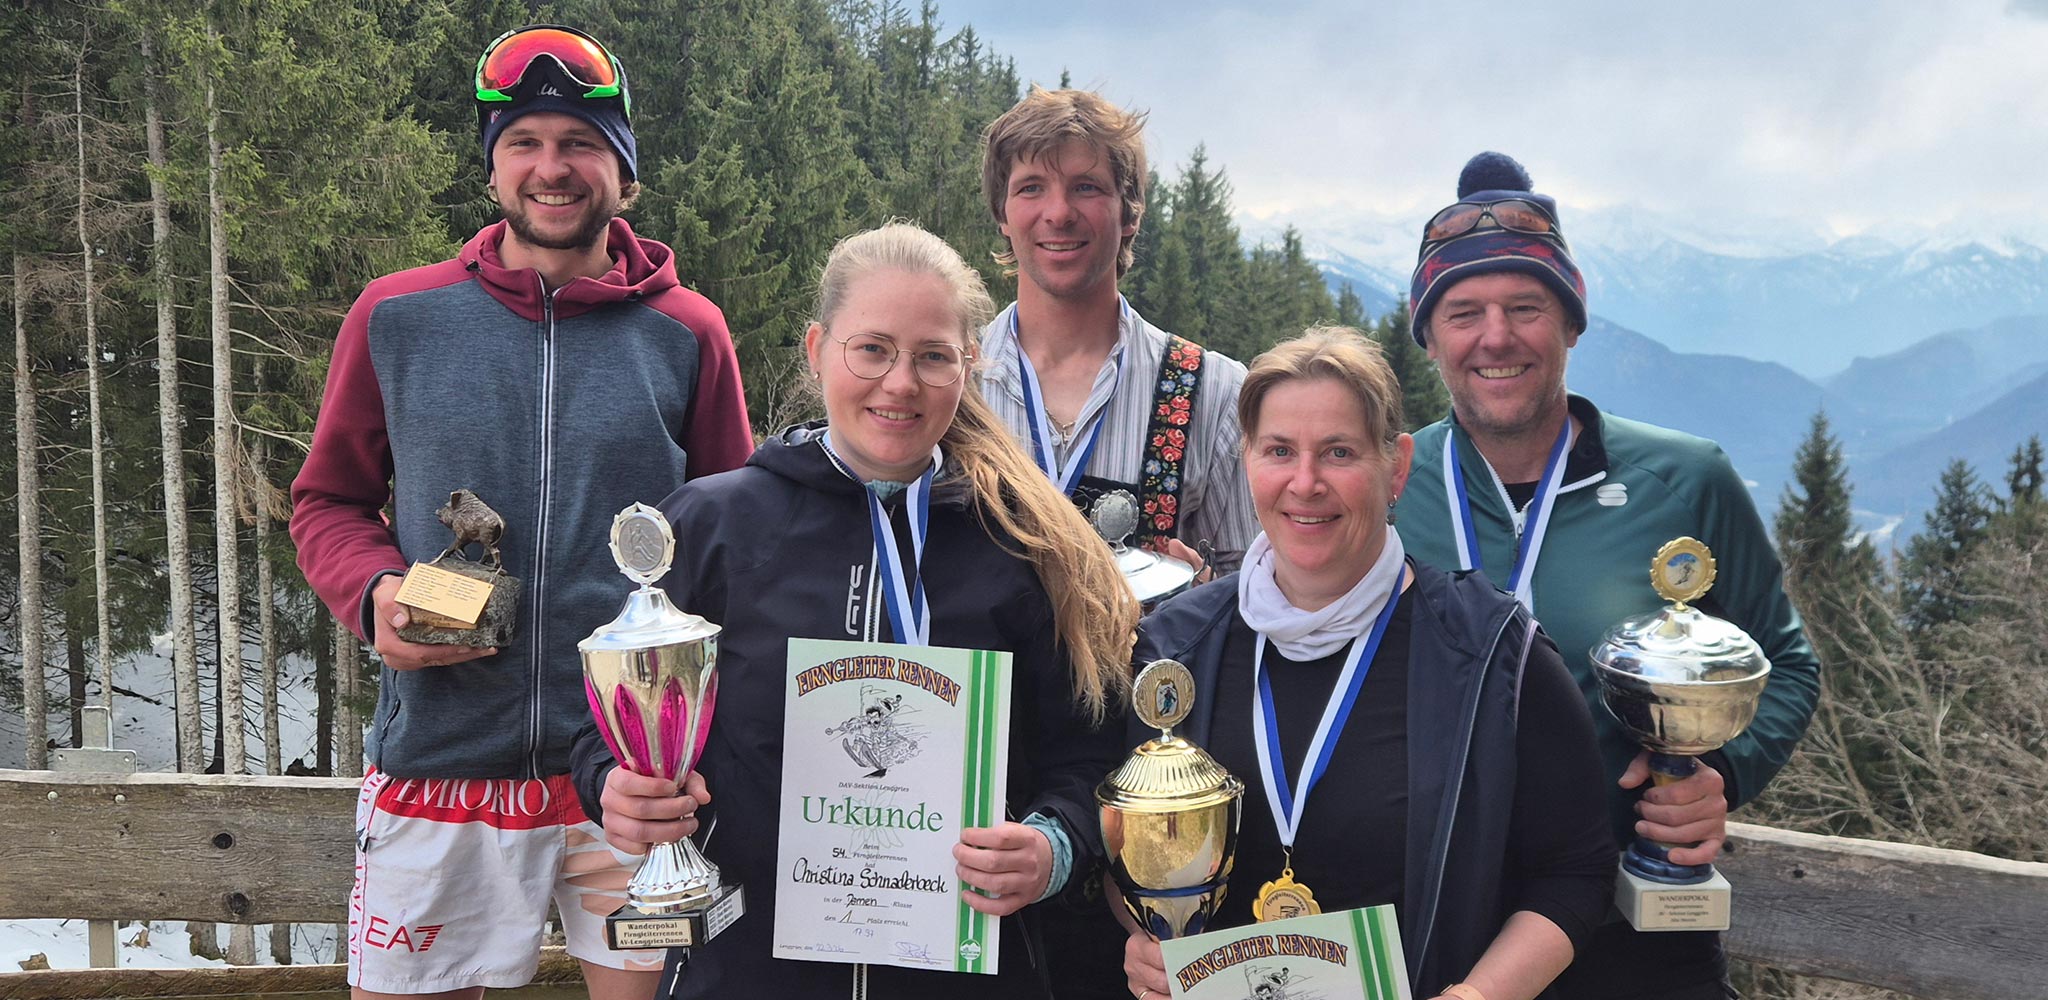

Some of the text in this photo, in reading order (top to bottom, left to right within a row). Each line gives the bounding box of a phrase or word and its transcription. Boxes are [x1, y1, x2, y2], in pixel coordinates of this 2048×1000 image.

[796, 655, 961, 707] FIRNGLEITER RENNEN
[801, 795, 943, 832] Urkunde
[792, 857, 854, 886] Christina
[365, 915, 445, 953] EA7
[627, 922, 677, 931] Wanderpokal
[1176, 934, 1348, 993] FIRNGLEITER RENNEN
